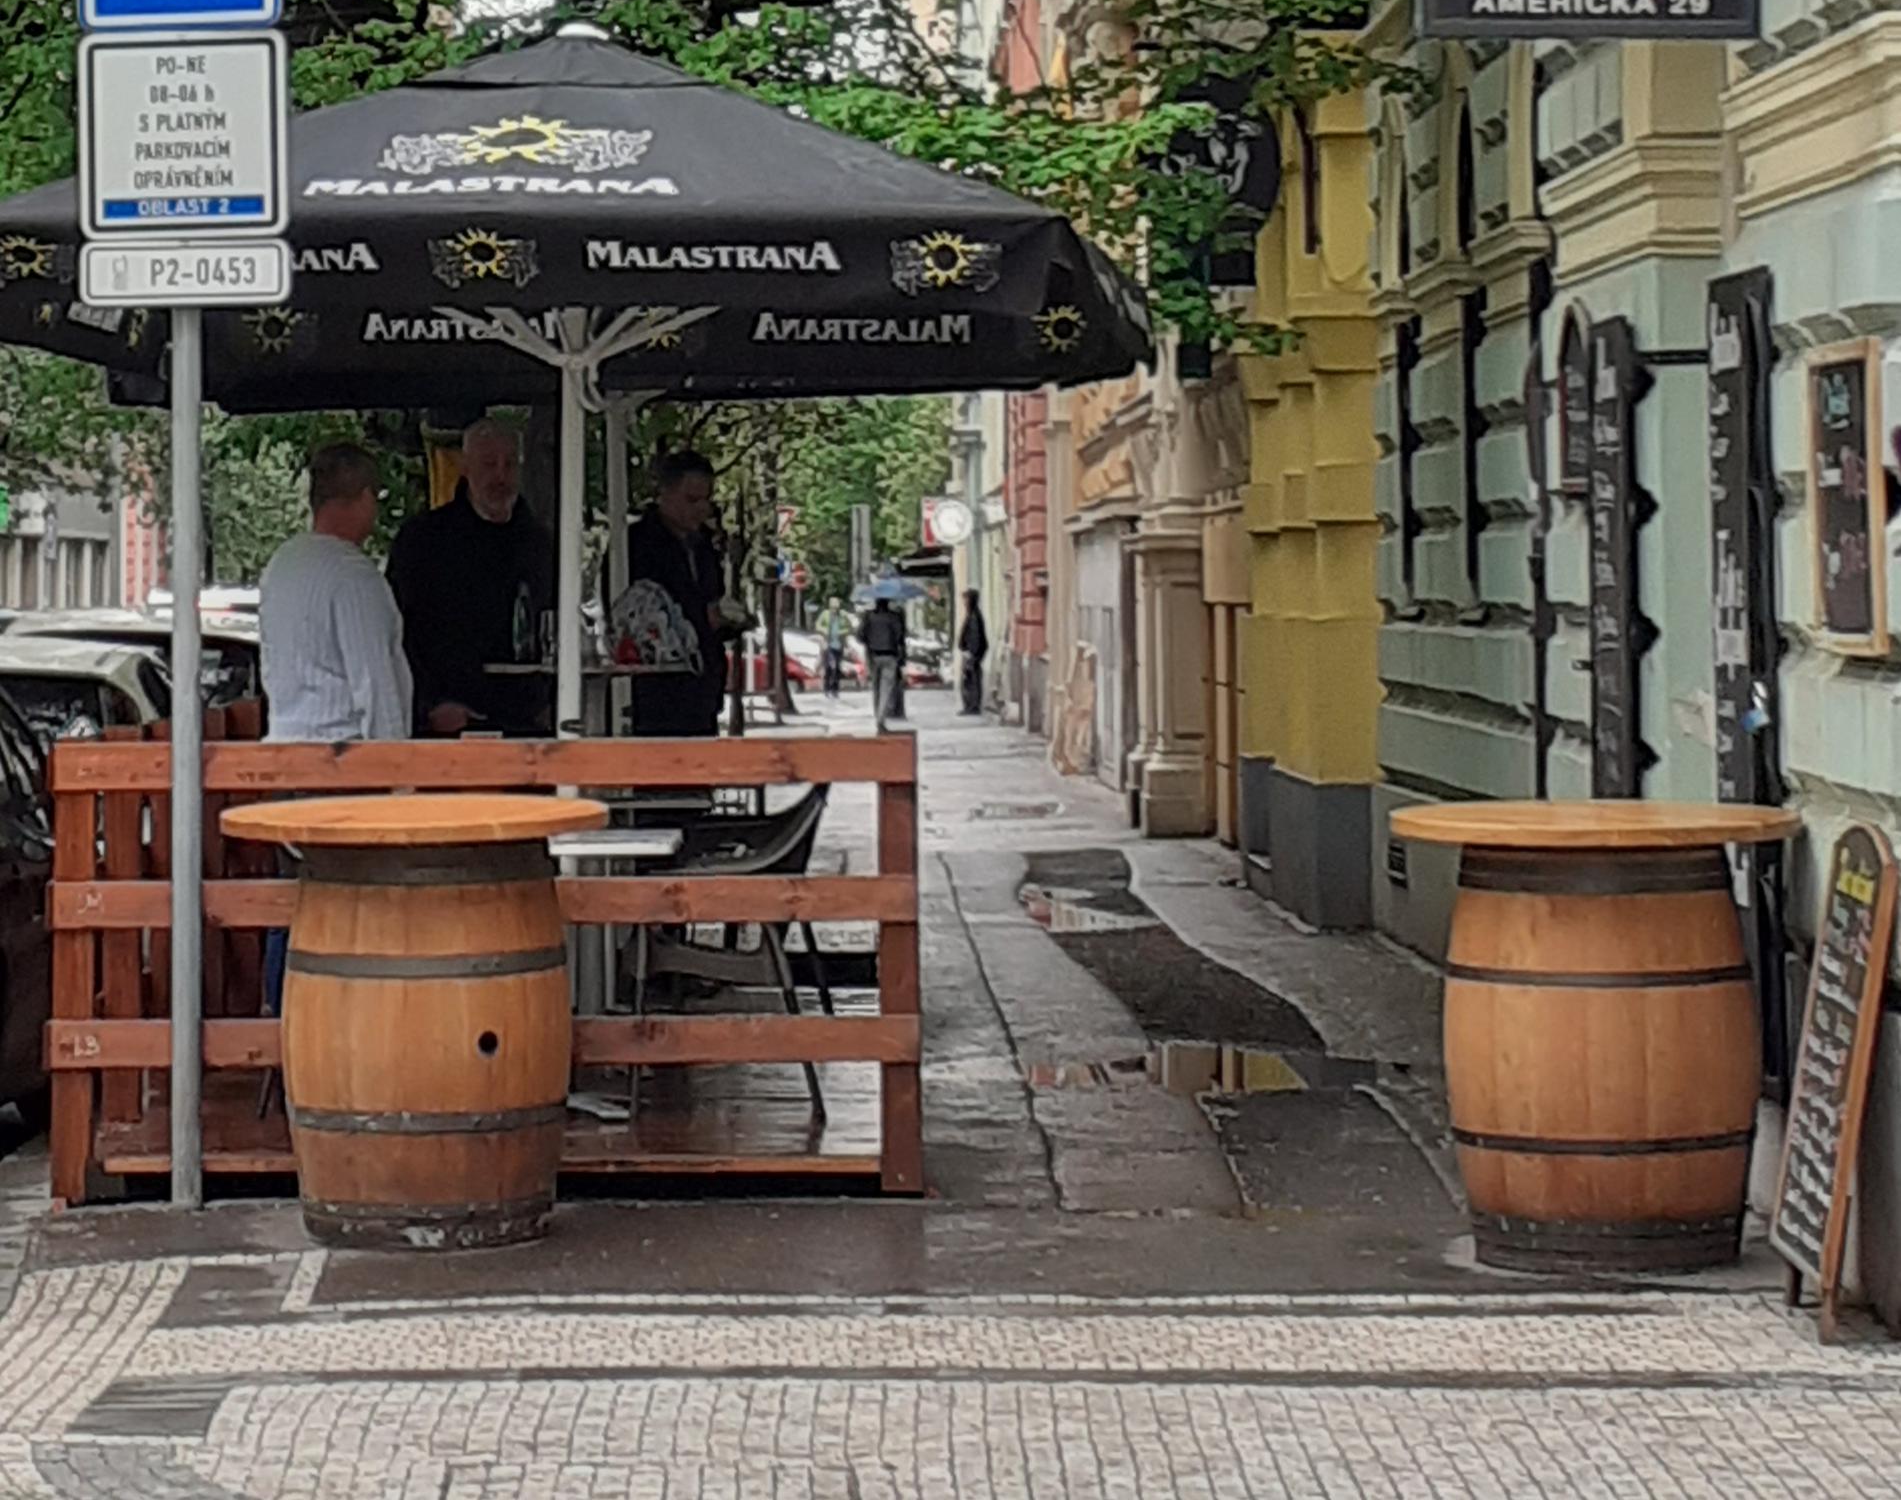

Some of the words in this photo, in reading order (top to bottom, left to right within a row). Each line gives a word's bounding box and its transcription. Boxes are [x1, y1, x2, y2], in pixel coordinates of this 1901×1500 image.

[156, 56, 206, 74] PO-NE
[138, 113, 149, 132] S
[156, 108, 227, 132] PLATNÝM
[302, 176, 680, 197] MALASTRANA
[137, 199, 209, 216] OBLAST
[218, 197, 230, 214] 2
[586, 240, 842, 271] MALASTRANA
[150, 257, 256, 287] P2-0453
